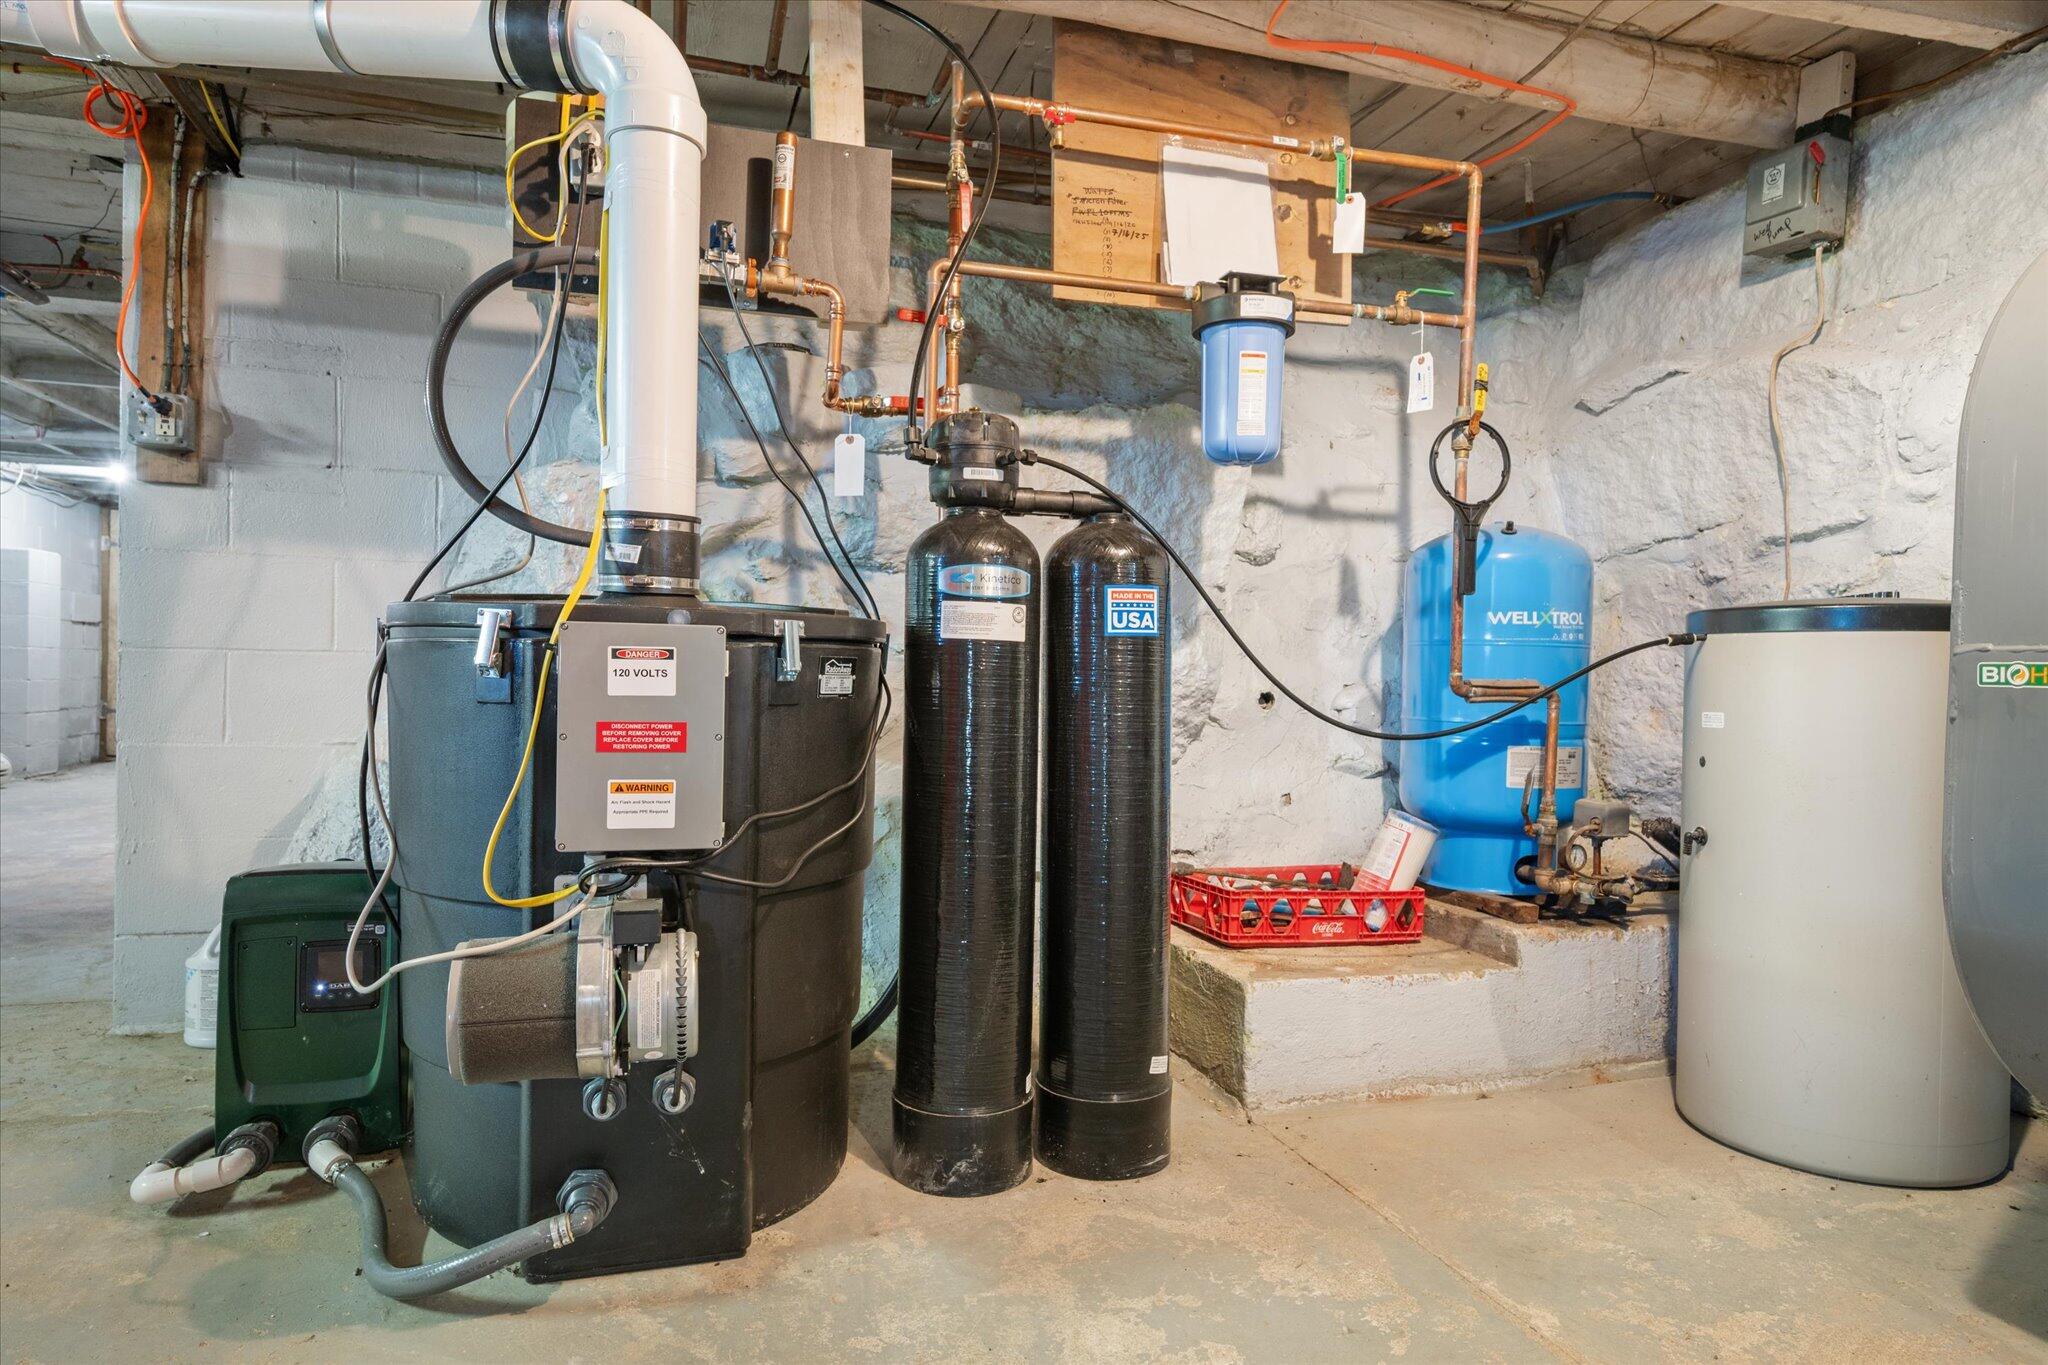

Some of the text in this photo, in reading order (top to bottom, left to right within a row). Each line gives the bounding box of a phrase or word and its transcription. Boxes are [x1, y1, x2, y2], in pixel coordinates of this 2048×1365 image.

[980, 573, 1022, 585] Kinetico
[1112, 611, 1155, 629] USA
[625, 650, 660, 659] DANGER
[613, 668, 668, 678] 120 VOLTS
[626, 784, 669, 792] WARNING
